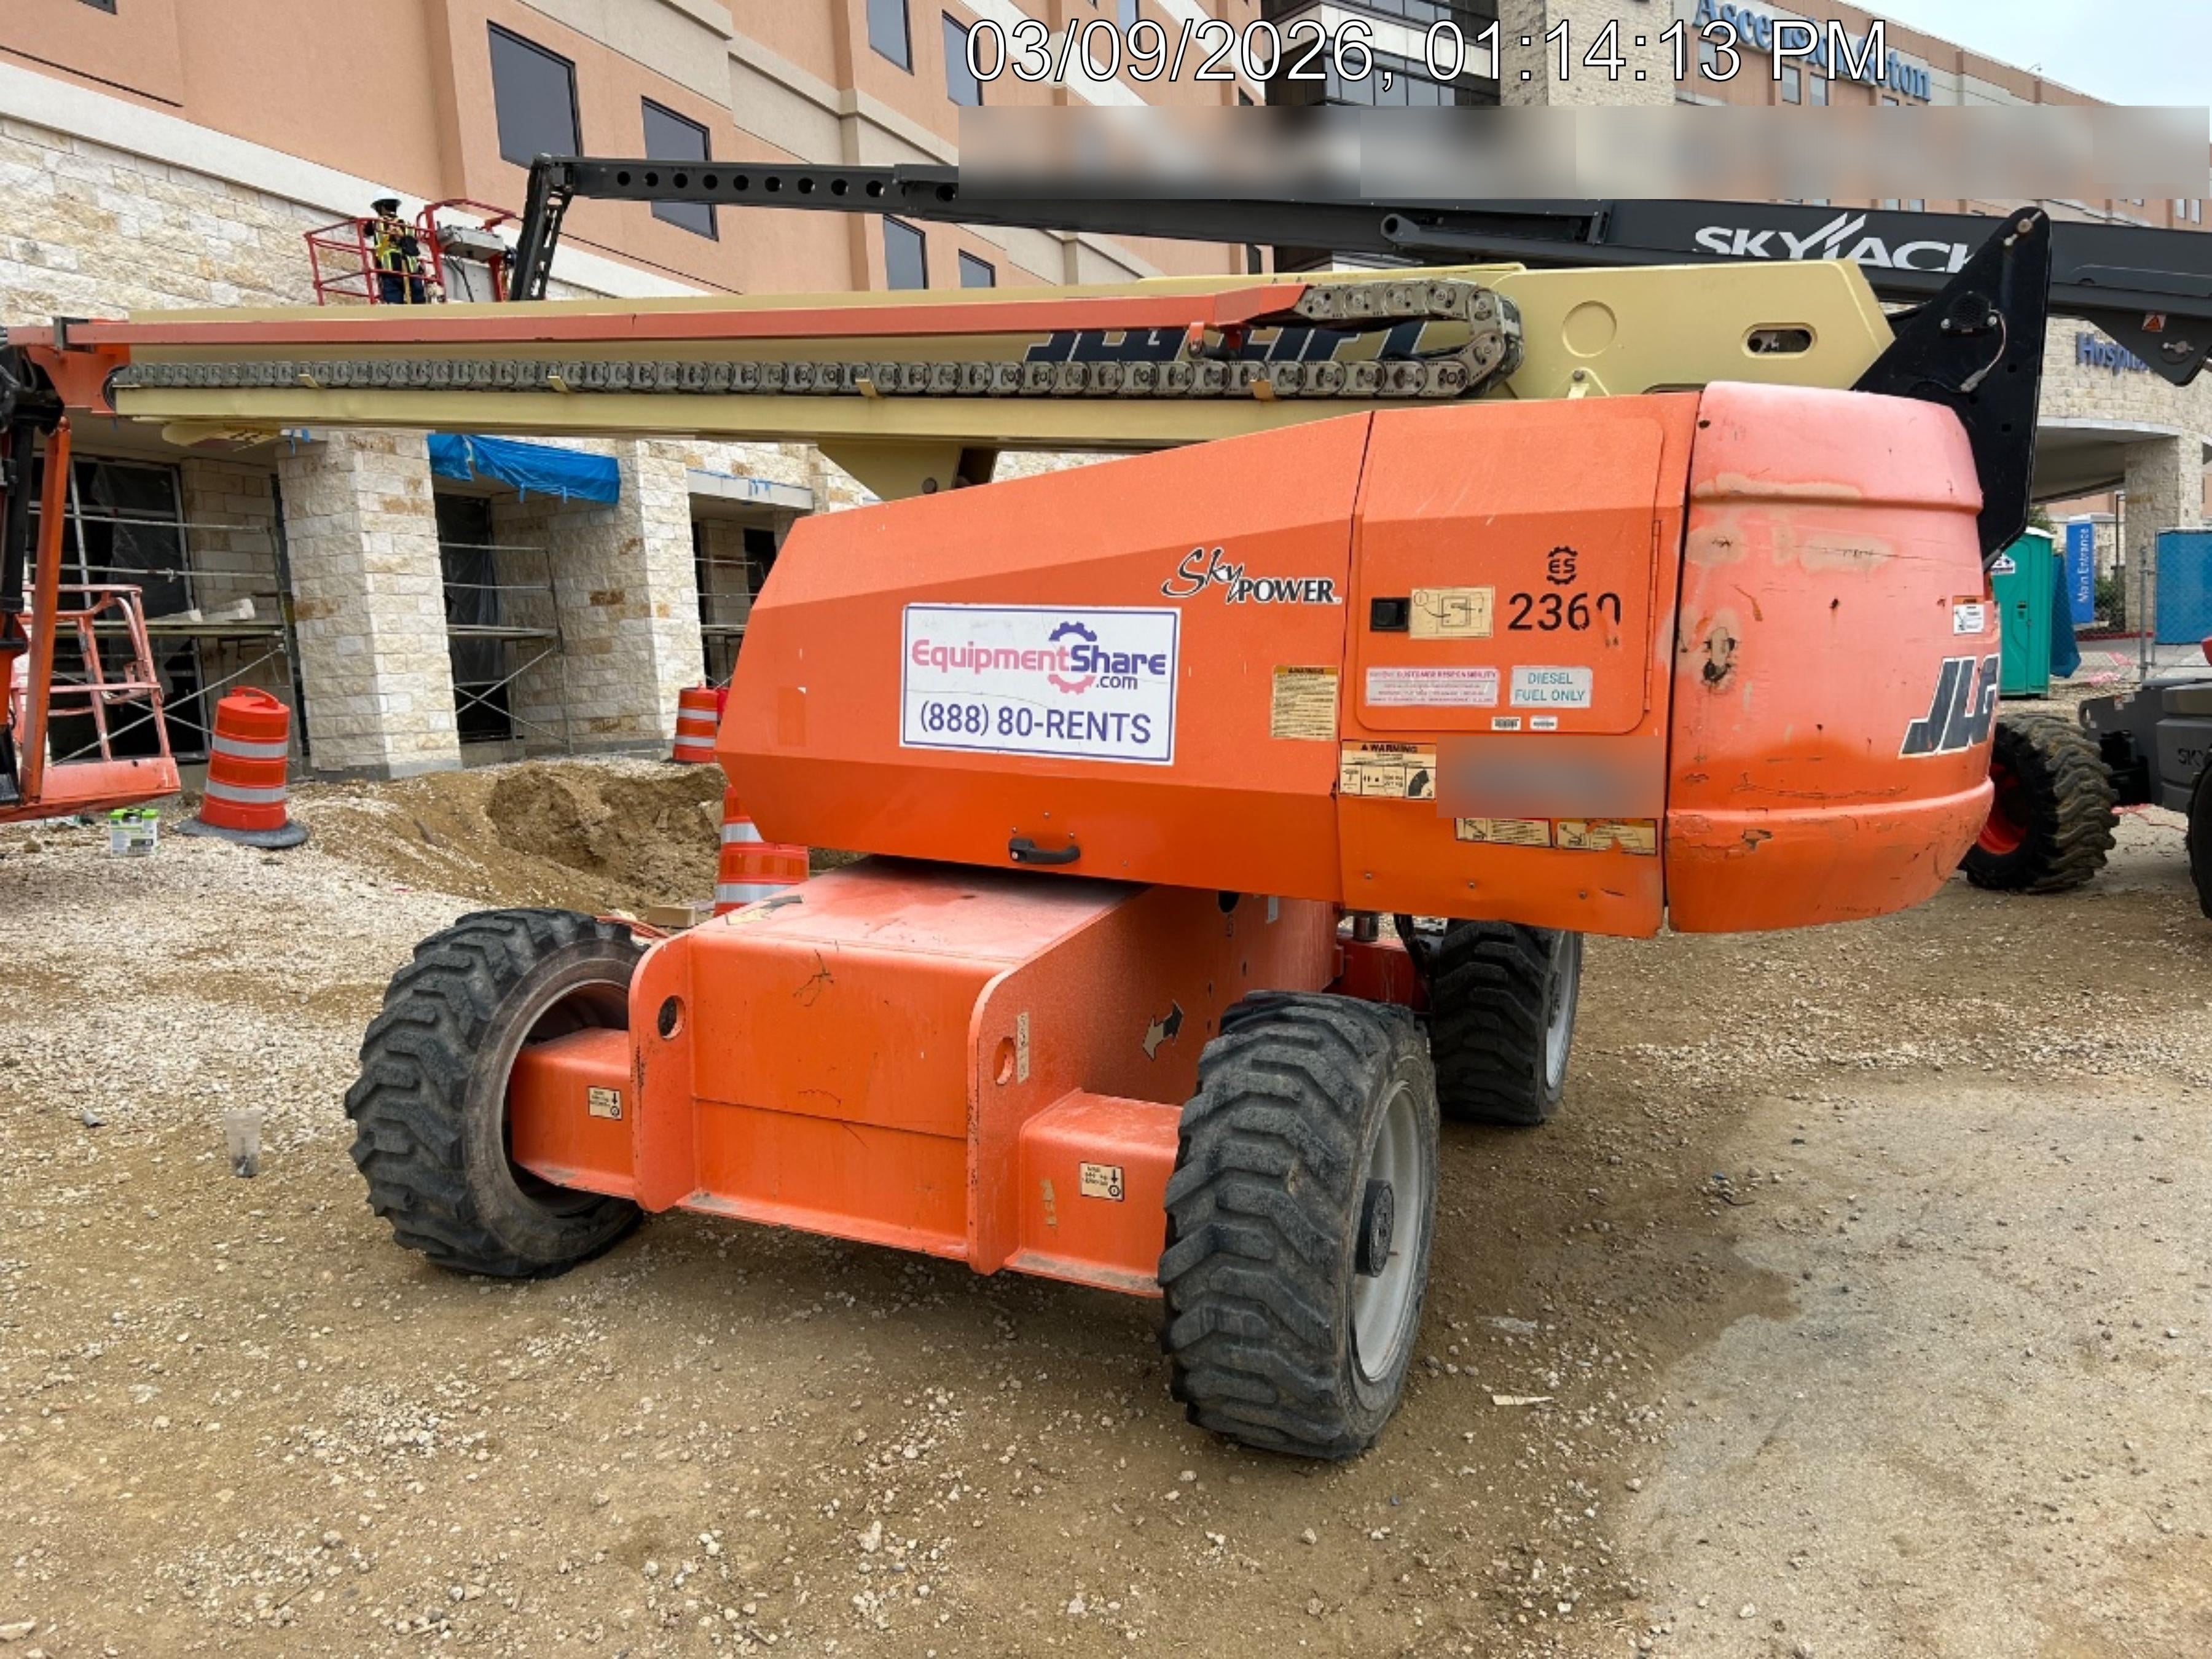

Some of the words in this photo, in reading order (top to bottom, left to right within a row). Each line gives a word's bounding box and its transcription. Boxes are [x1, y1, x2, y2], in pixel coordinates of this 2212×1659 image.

[2077, 528, 2089, 574] Entrance
[2077, 576, 2089, 603] Main
[912, 639, 1166, 675] EquipmentShare
[1096, 676, 1138, 690] .com
[1528, 672, 1573, 684] DIESEL
[1515, 689, 1548, 701] FUEL
[1551, 689, 1585, 702] ONLY
[922, 700, 989, 735] (888)
[997, 707, 1151, 744] 80-RENTS
